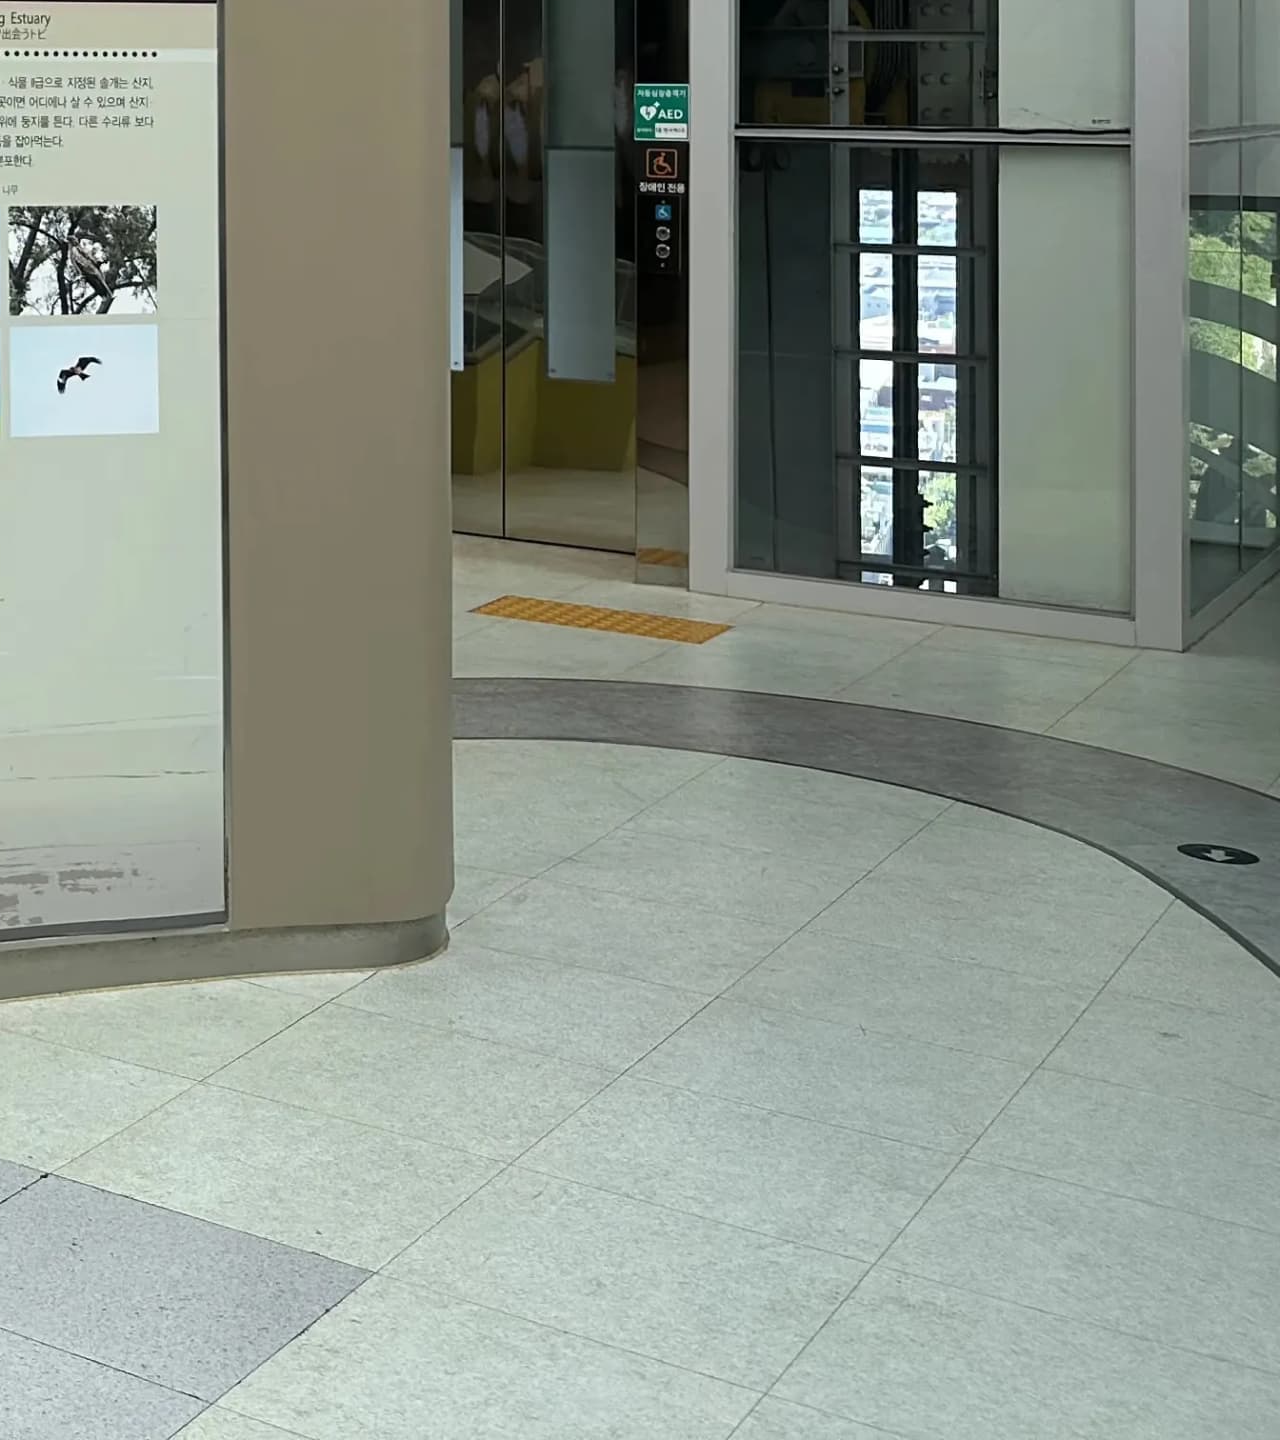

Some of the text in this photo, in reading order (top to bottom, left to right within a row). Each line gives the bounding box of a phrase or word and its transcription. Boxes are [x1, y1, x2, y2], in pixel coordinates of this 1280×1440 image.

[11, 12, 50, 30] Estuary
[9, 77, 26, 89] 식물
[68, 77, 95, 89] 지정된
[100, 77, 128, 89] 솔개는
[29, 96, 67, 108] 어디에나
[97, 96, 125, 108] 있으며
[657, 108, 684, 120] AED
[0, 116, 17, 128] 위에
[21, 116, 49, 128] 둥지를
[79, 116, 98, 128] 다른
[102, 116, 131, 128] 수리류
[135, 116, 154, 128] 보다
[639, 182, 666, 193] 장애인
